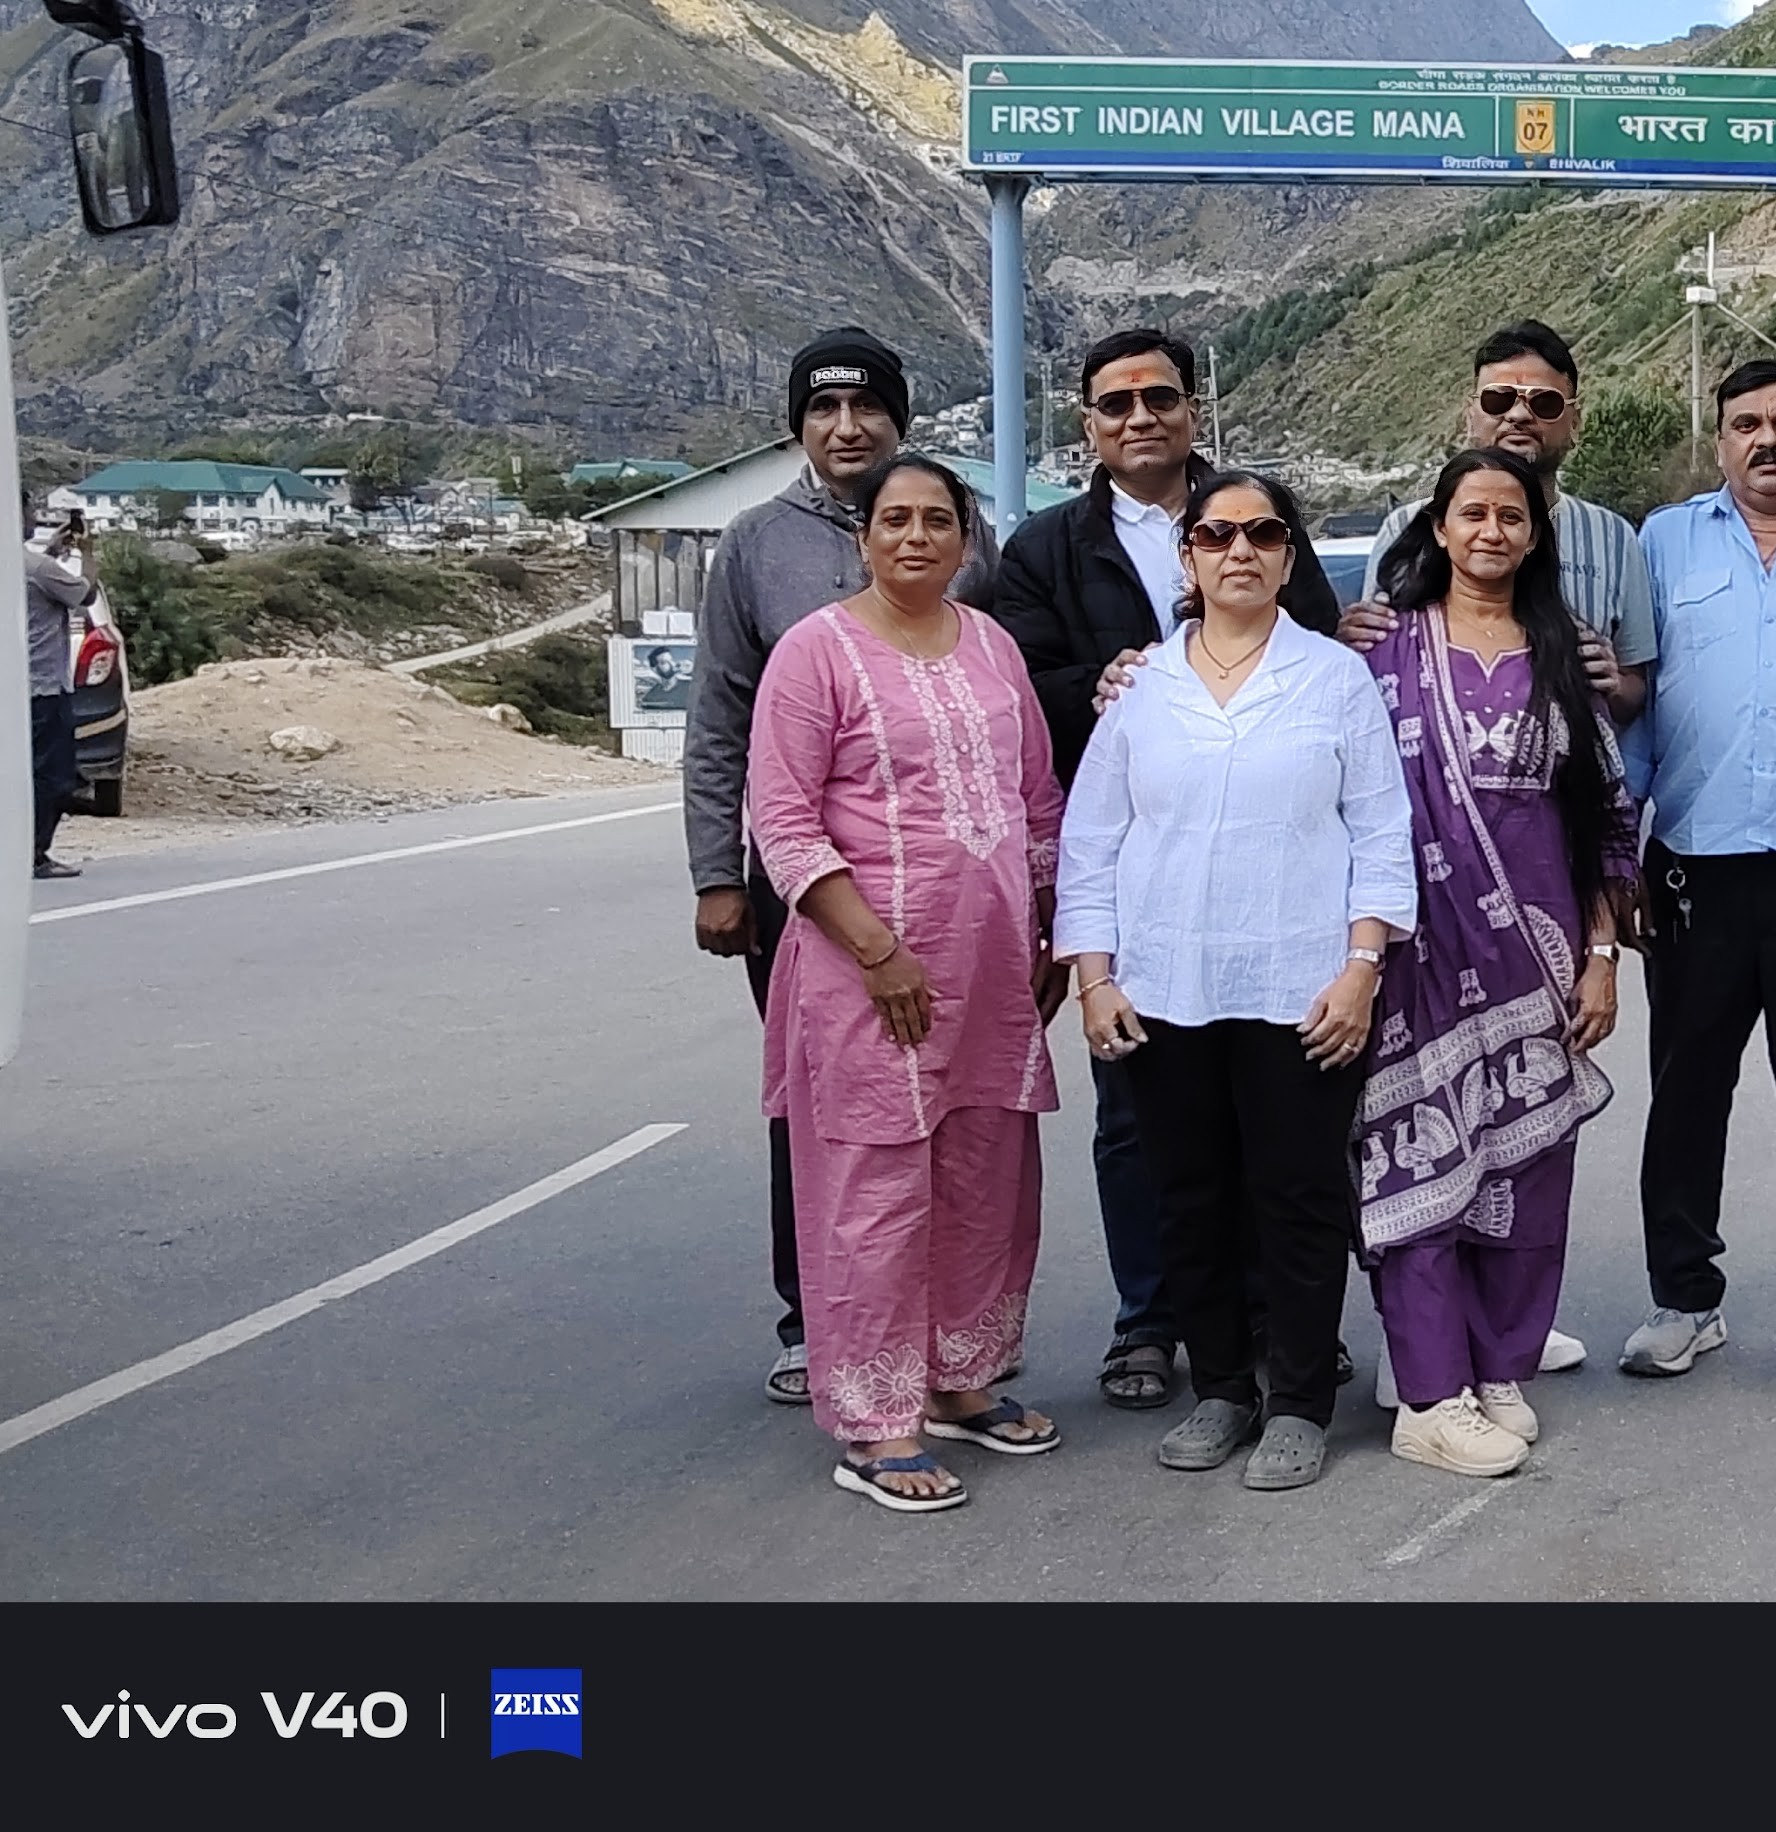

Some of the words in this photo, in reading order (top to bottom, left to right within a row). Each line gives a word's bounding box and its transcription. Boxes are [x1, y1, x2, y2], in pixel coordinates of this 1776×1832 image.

[1378, 80, 1435, 91] BORDER
[1437, 80, 1485, 92] ROADS
[1487, 81, 1583, 95] ORGANISATION
[1584, 84, 1657, 96] WELCOMES
[1658, 86, 1686, 97] YOU
[991, 105, 1083, 135] FIRST
[1098, 106, 1204, 136] INDIAN
[1220, 107, 1355, 137] VILLAGE
[1373, 110, 1466, 139] MANA
[1618, 115, 1708, 142] भारत
[1727, 117, 1776, 145] का
[1523, 122, 1548, 142] 07
[1442, 155, 1510, 170] शिवालिक
[1549, 158, 1616, 171] SHIVALIK
